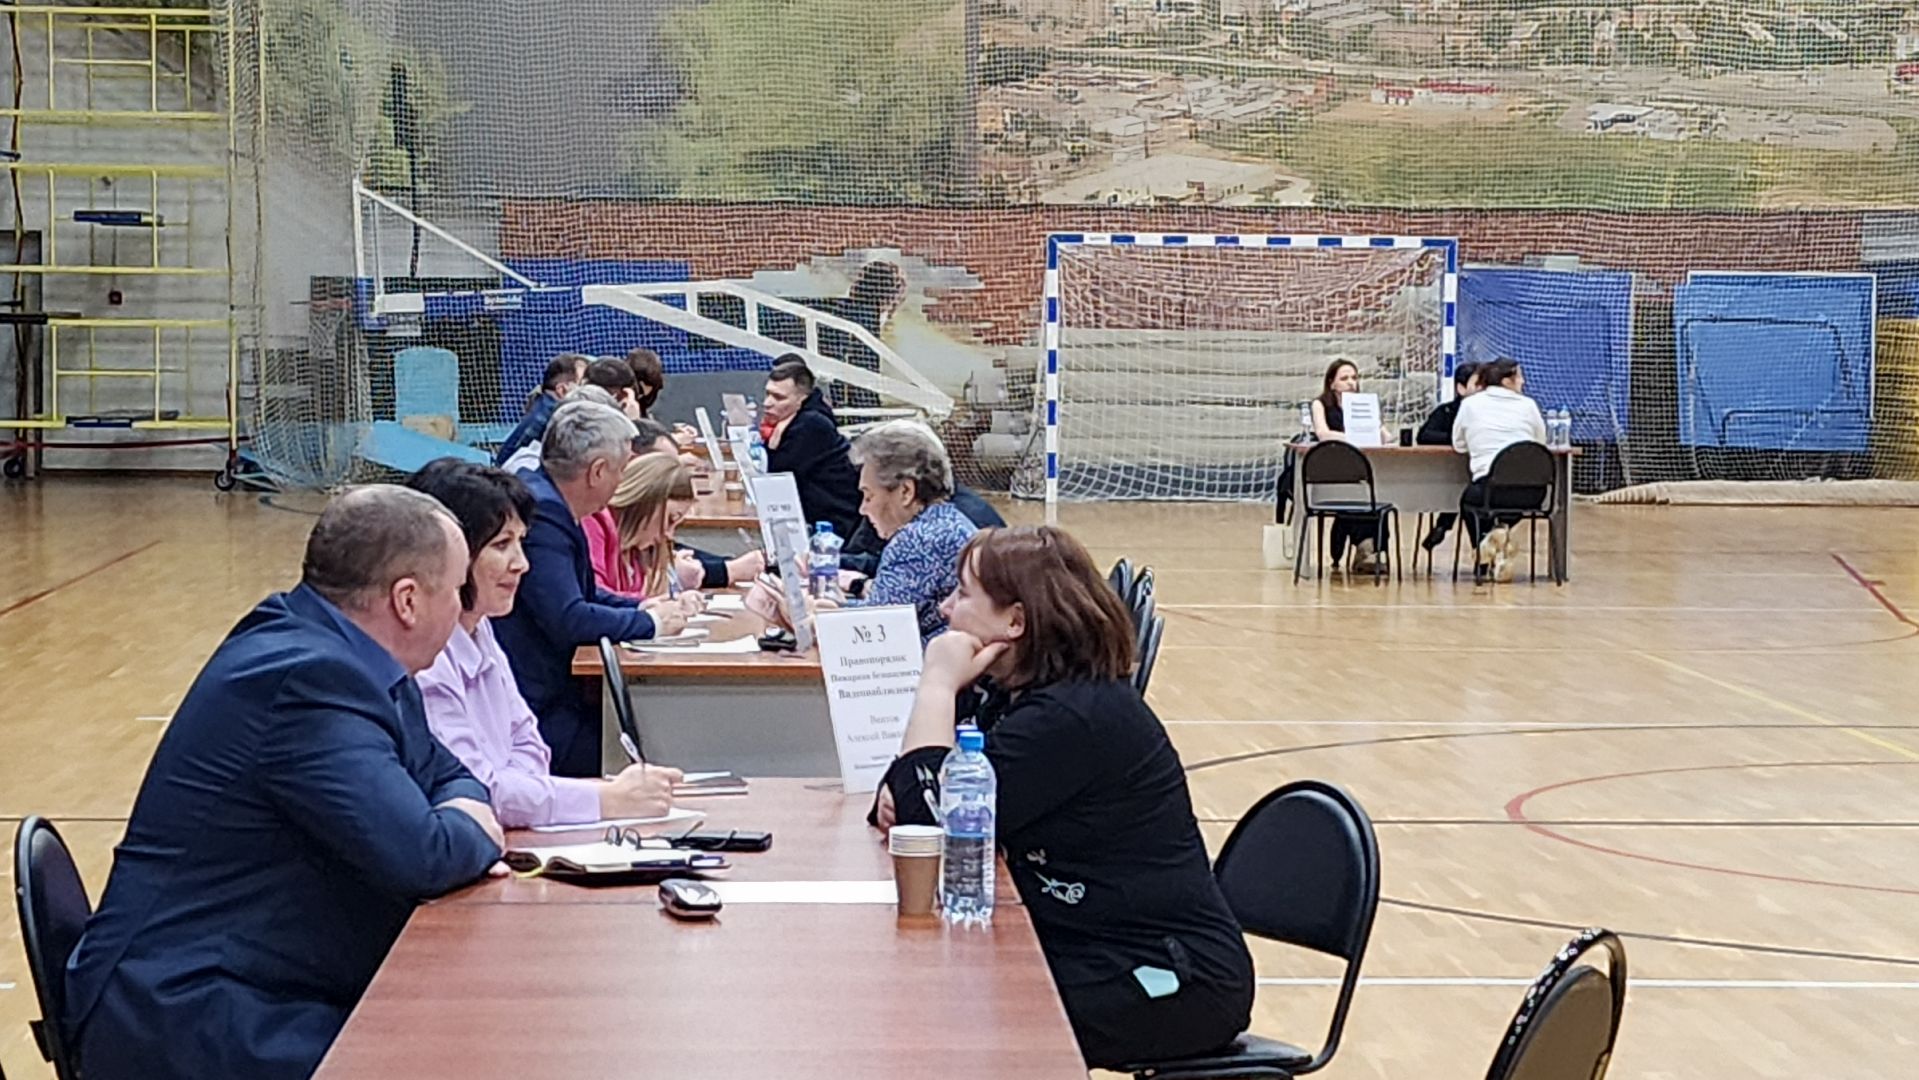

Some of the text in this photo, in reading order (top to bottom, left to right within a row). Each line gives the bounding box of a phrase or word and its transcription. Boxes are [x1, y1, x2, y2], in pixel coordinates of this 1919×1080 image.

[852, 624, 887, 644] № 3
[840, 655, 907, 667] Правопорядок
[831, 673, 871, 683] Пожарная
[838, 686, 916, 699] Видеонаблюдени
